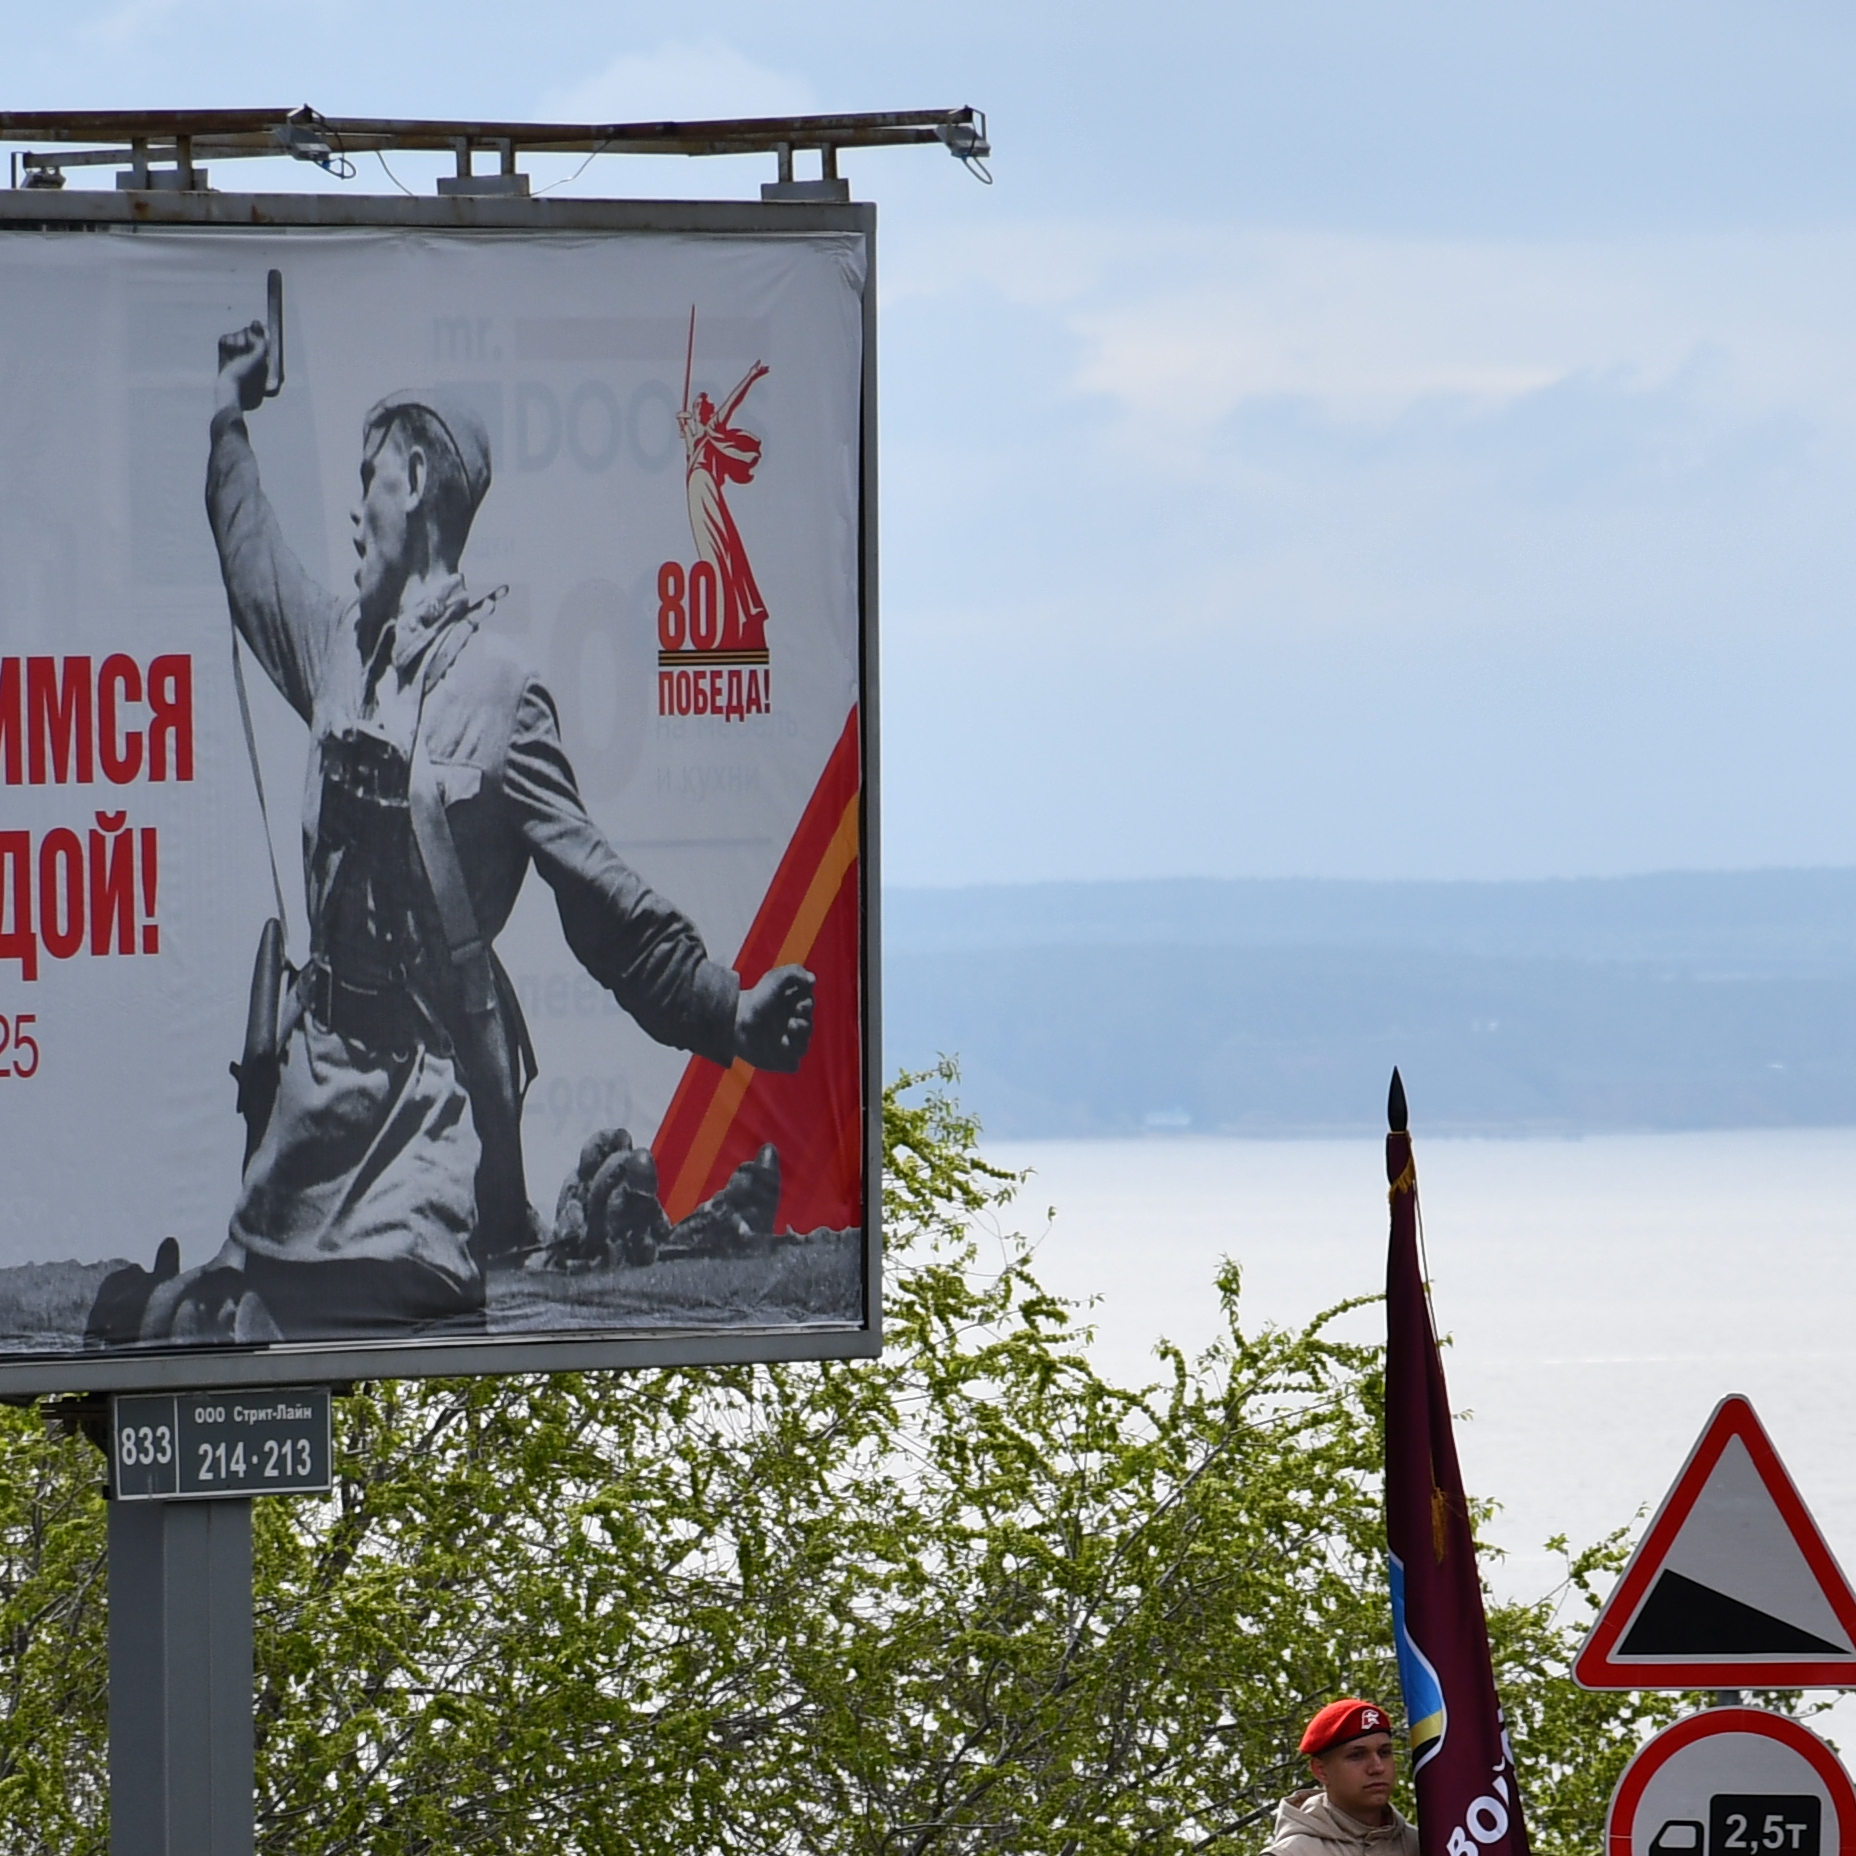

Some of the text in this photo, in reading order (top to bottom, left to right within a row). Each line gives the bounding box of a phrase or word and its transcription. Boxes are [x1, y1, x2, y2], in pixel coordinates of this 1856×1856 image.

[657, 560, 718, 651] 80
[658, 668, 771, 723] ПОБЕДА!
[194, 1403, 313, 1425] ООО Стрит-Лайн
[121, 1425, 173, 1466] 833
[1723, 1813, 1808, 1856] 2,5т
